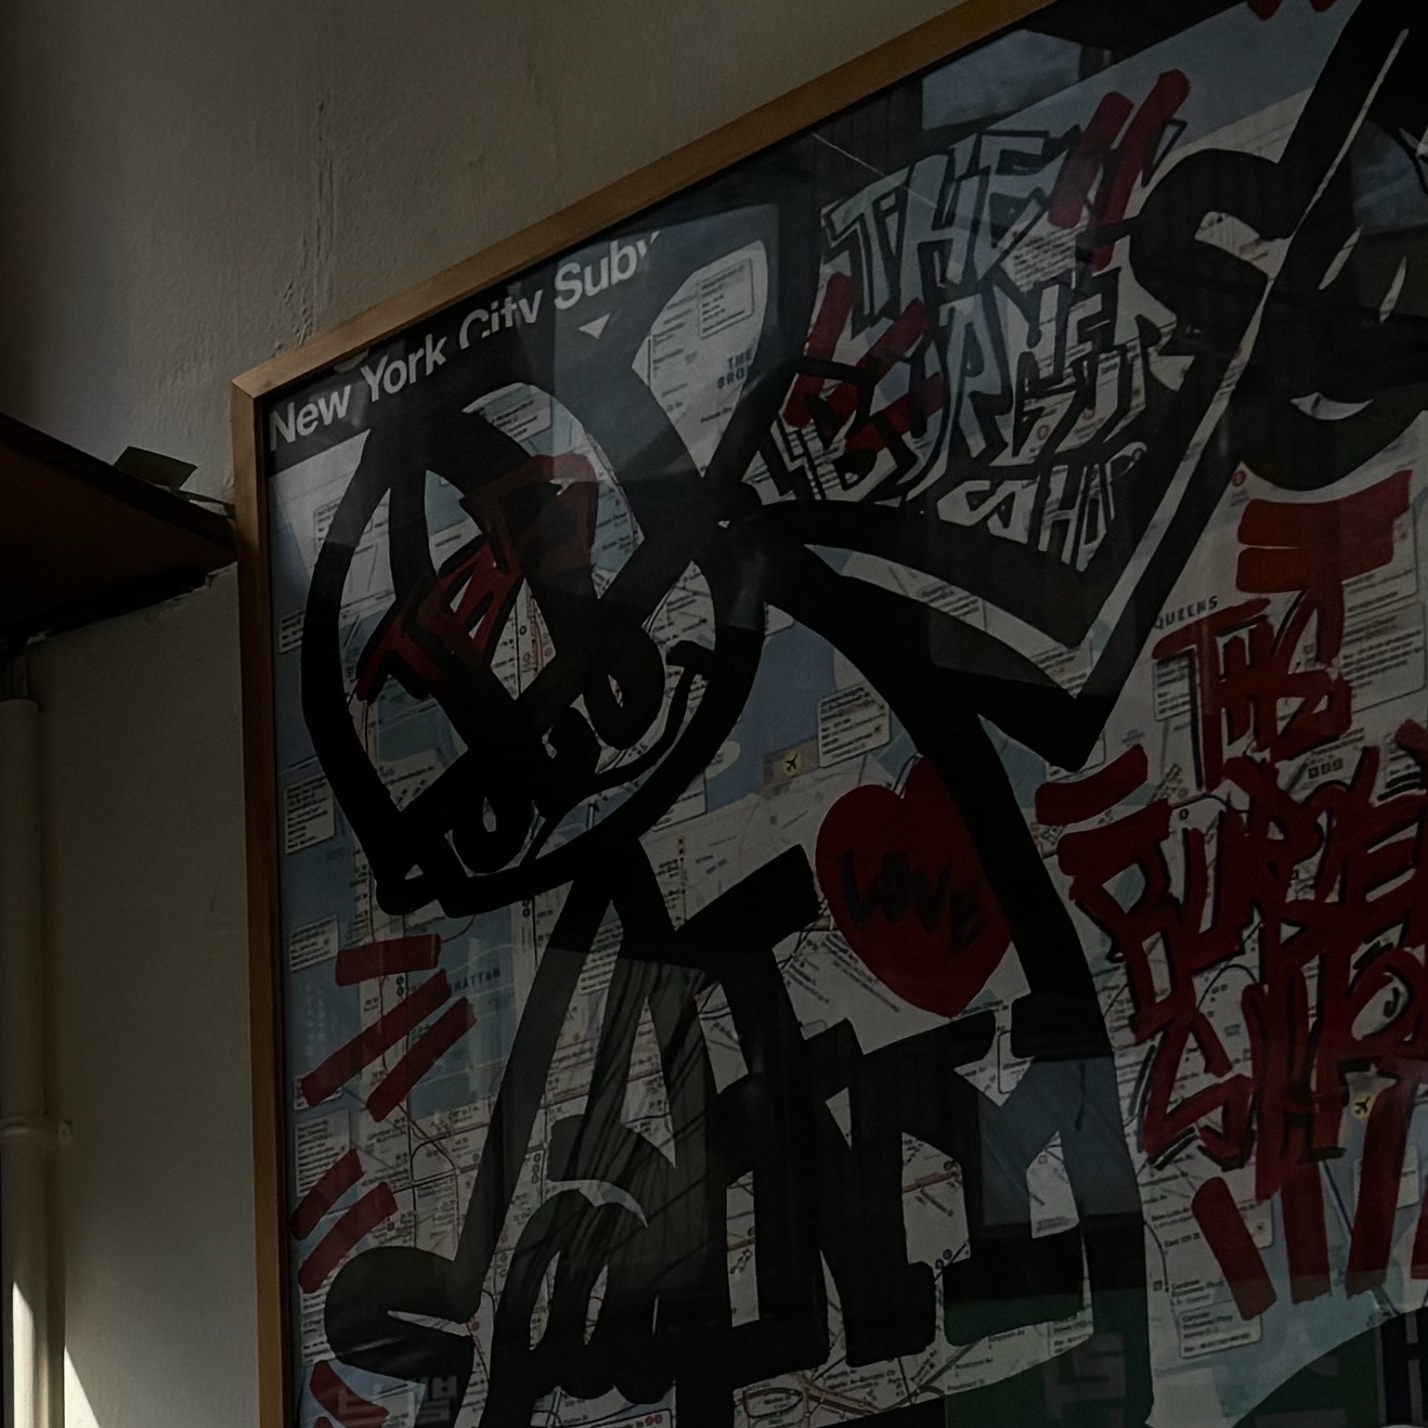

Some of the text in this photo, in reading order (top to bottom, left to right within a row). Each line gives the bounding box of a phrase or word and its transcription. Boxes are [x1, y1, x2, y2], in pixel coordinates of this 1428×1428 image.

[717, 367, 750, 389] BRO
[270, 386, 351, 451] New
[361, 333, 447, 402] York
[453, 967, 501, 991] HATTAN
